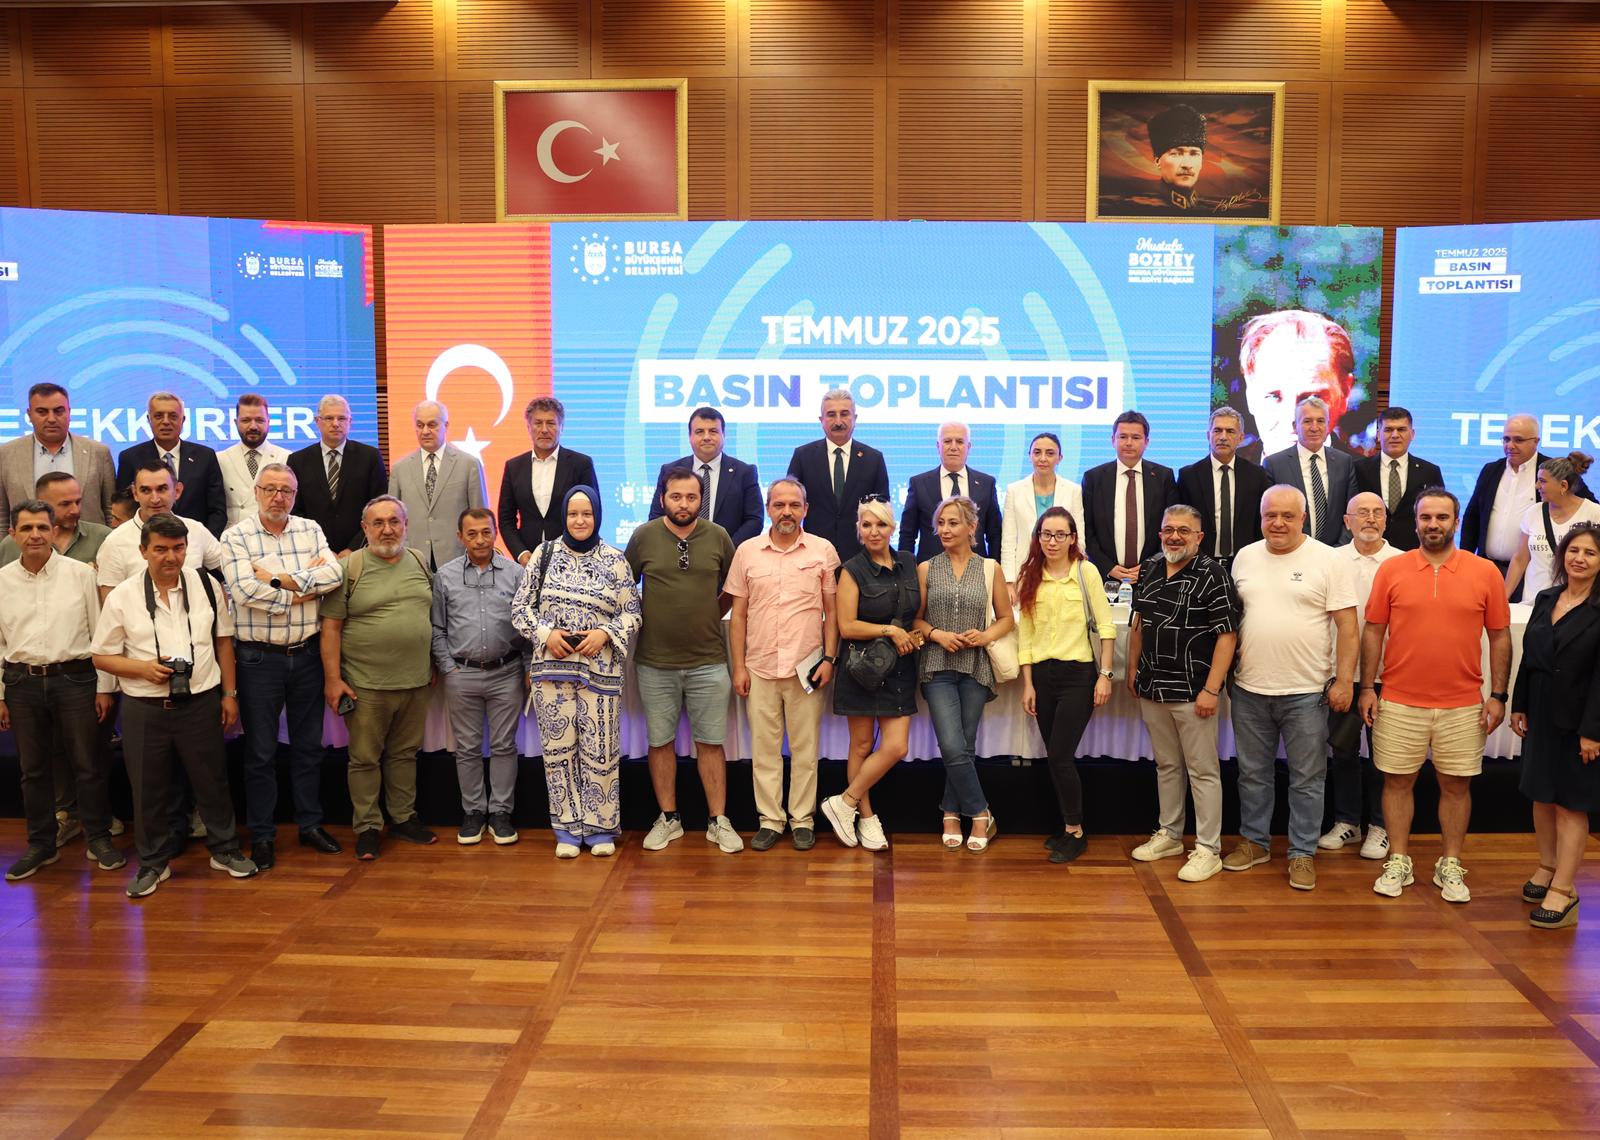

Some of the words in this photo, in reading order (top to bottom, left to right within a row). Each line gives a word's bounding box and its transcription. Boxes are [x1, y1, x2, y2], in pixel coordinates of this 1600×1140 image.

[624, 241, 683, 255] BURSA
[1135, 237, 1184, 254] Mustafa
[1434, 249, 1479, 257] TEMMUZ
[1482, 247, 1507, 257] 2025
[270, 256, 304, 265] BURSA
[1128, 252, 1195, 267] BOZBEY
[1449, 262, 1491, 271] BASIN
[1426, 279, 1513, 291] TOPLANTISI
[761, 316, 909, 345] TEMMUZ
[917, 315, 1000, 347] 2025
[654, 374, 801, 408] BASIN
[819, 374, 1109, 410] TOPLANTISI
